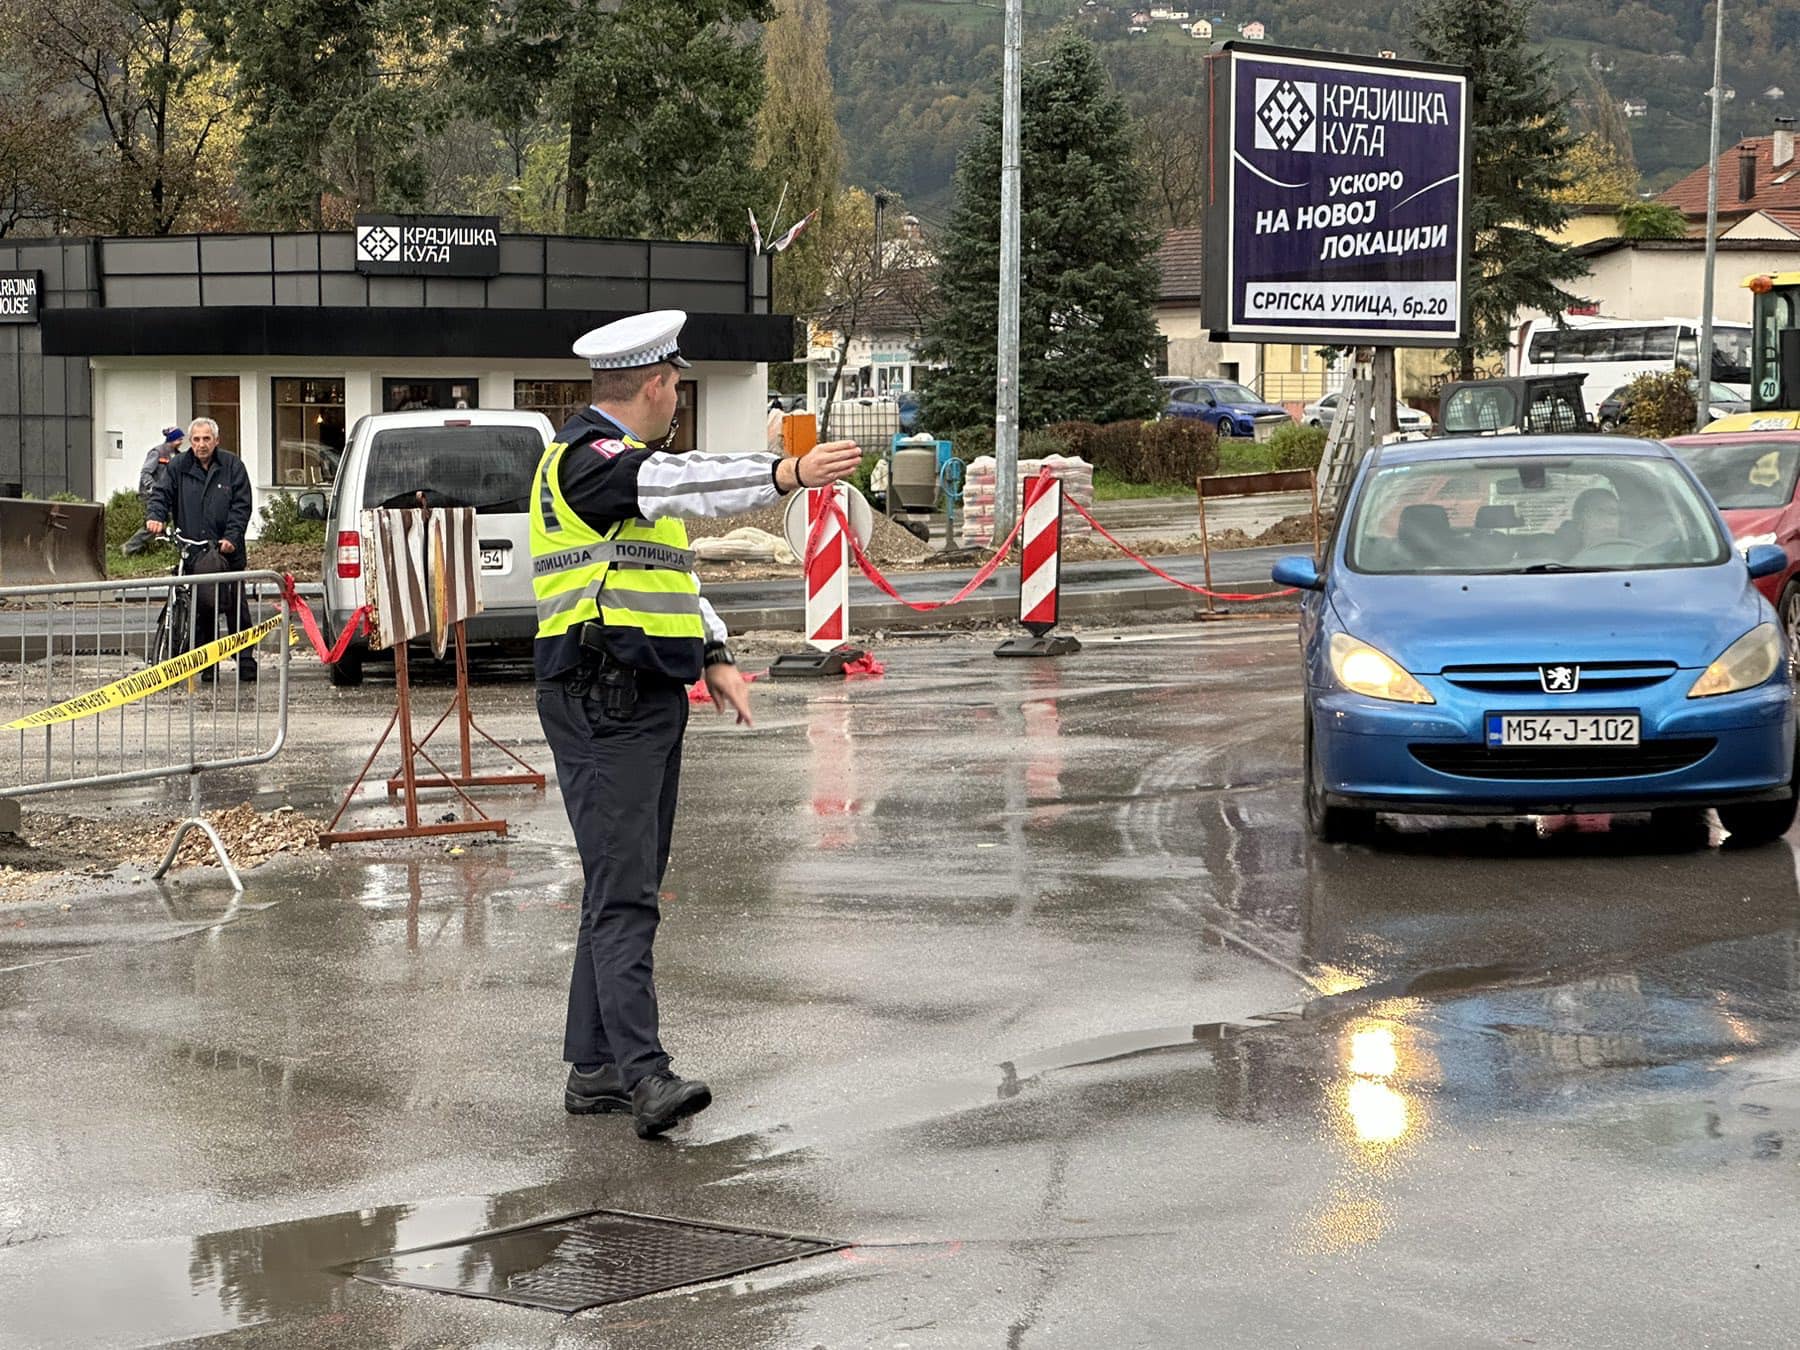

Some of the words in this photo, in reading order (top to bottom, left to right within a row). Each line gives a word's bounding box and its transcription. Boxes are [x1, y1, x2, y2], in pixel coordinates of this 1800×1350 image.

[1322, 83, 1449, 125] КРАЈИШКА
[1322, 121, 1385, 157] КУЋА
[1328, 170, 1404, 197] УСКОРО
[1255, 209, 1290, 235] НА
[1296, 200, 1376, 231] НОВОЈ
[403, 226, 497, 246] КРАЈИШКА
[1320, 224, 1448, 260] ЛОКАЦИЈИ
[403, 245, 450, 263] КУЋА
[0, 278, 37, 296] RAJINA
[1252, 291, 1326, 312] СРПСКА
[1331, 294, 1398, 317] УЛИЦА,
[1402, 297, 1448, 318] бр.20
[1762, 381, 1776, 398] 20
[615, 544, 686, 566] ПОЛИЦИЈА
[161, 647, 209, 681] КОМУНАЛНА
[116, 668, 162, 698] ПОЛИЦИЈА
[1506, 719, 1635, 742] M54-J-102
